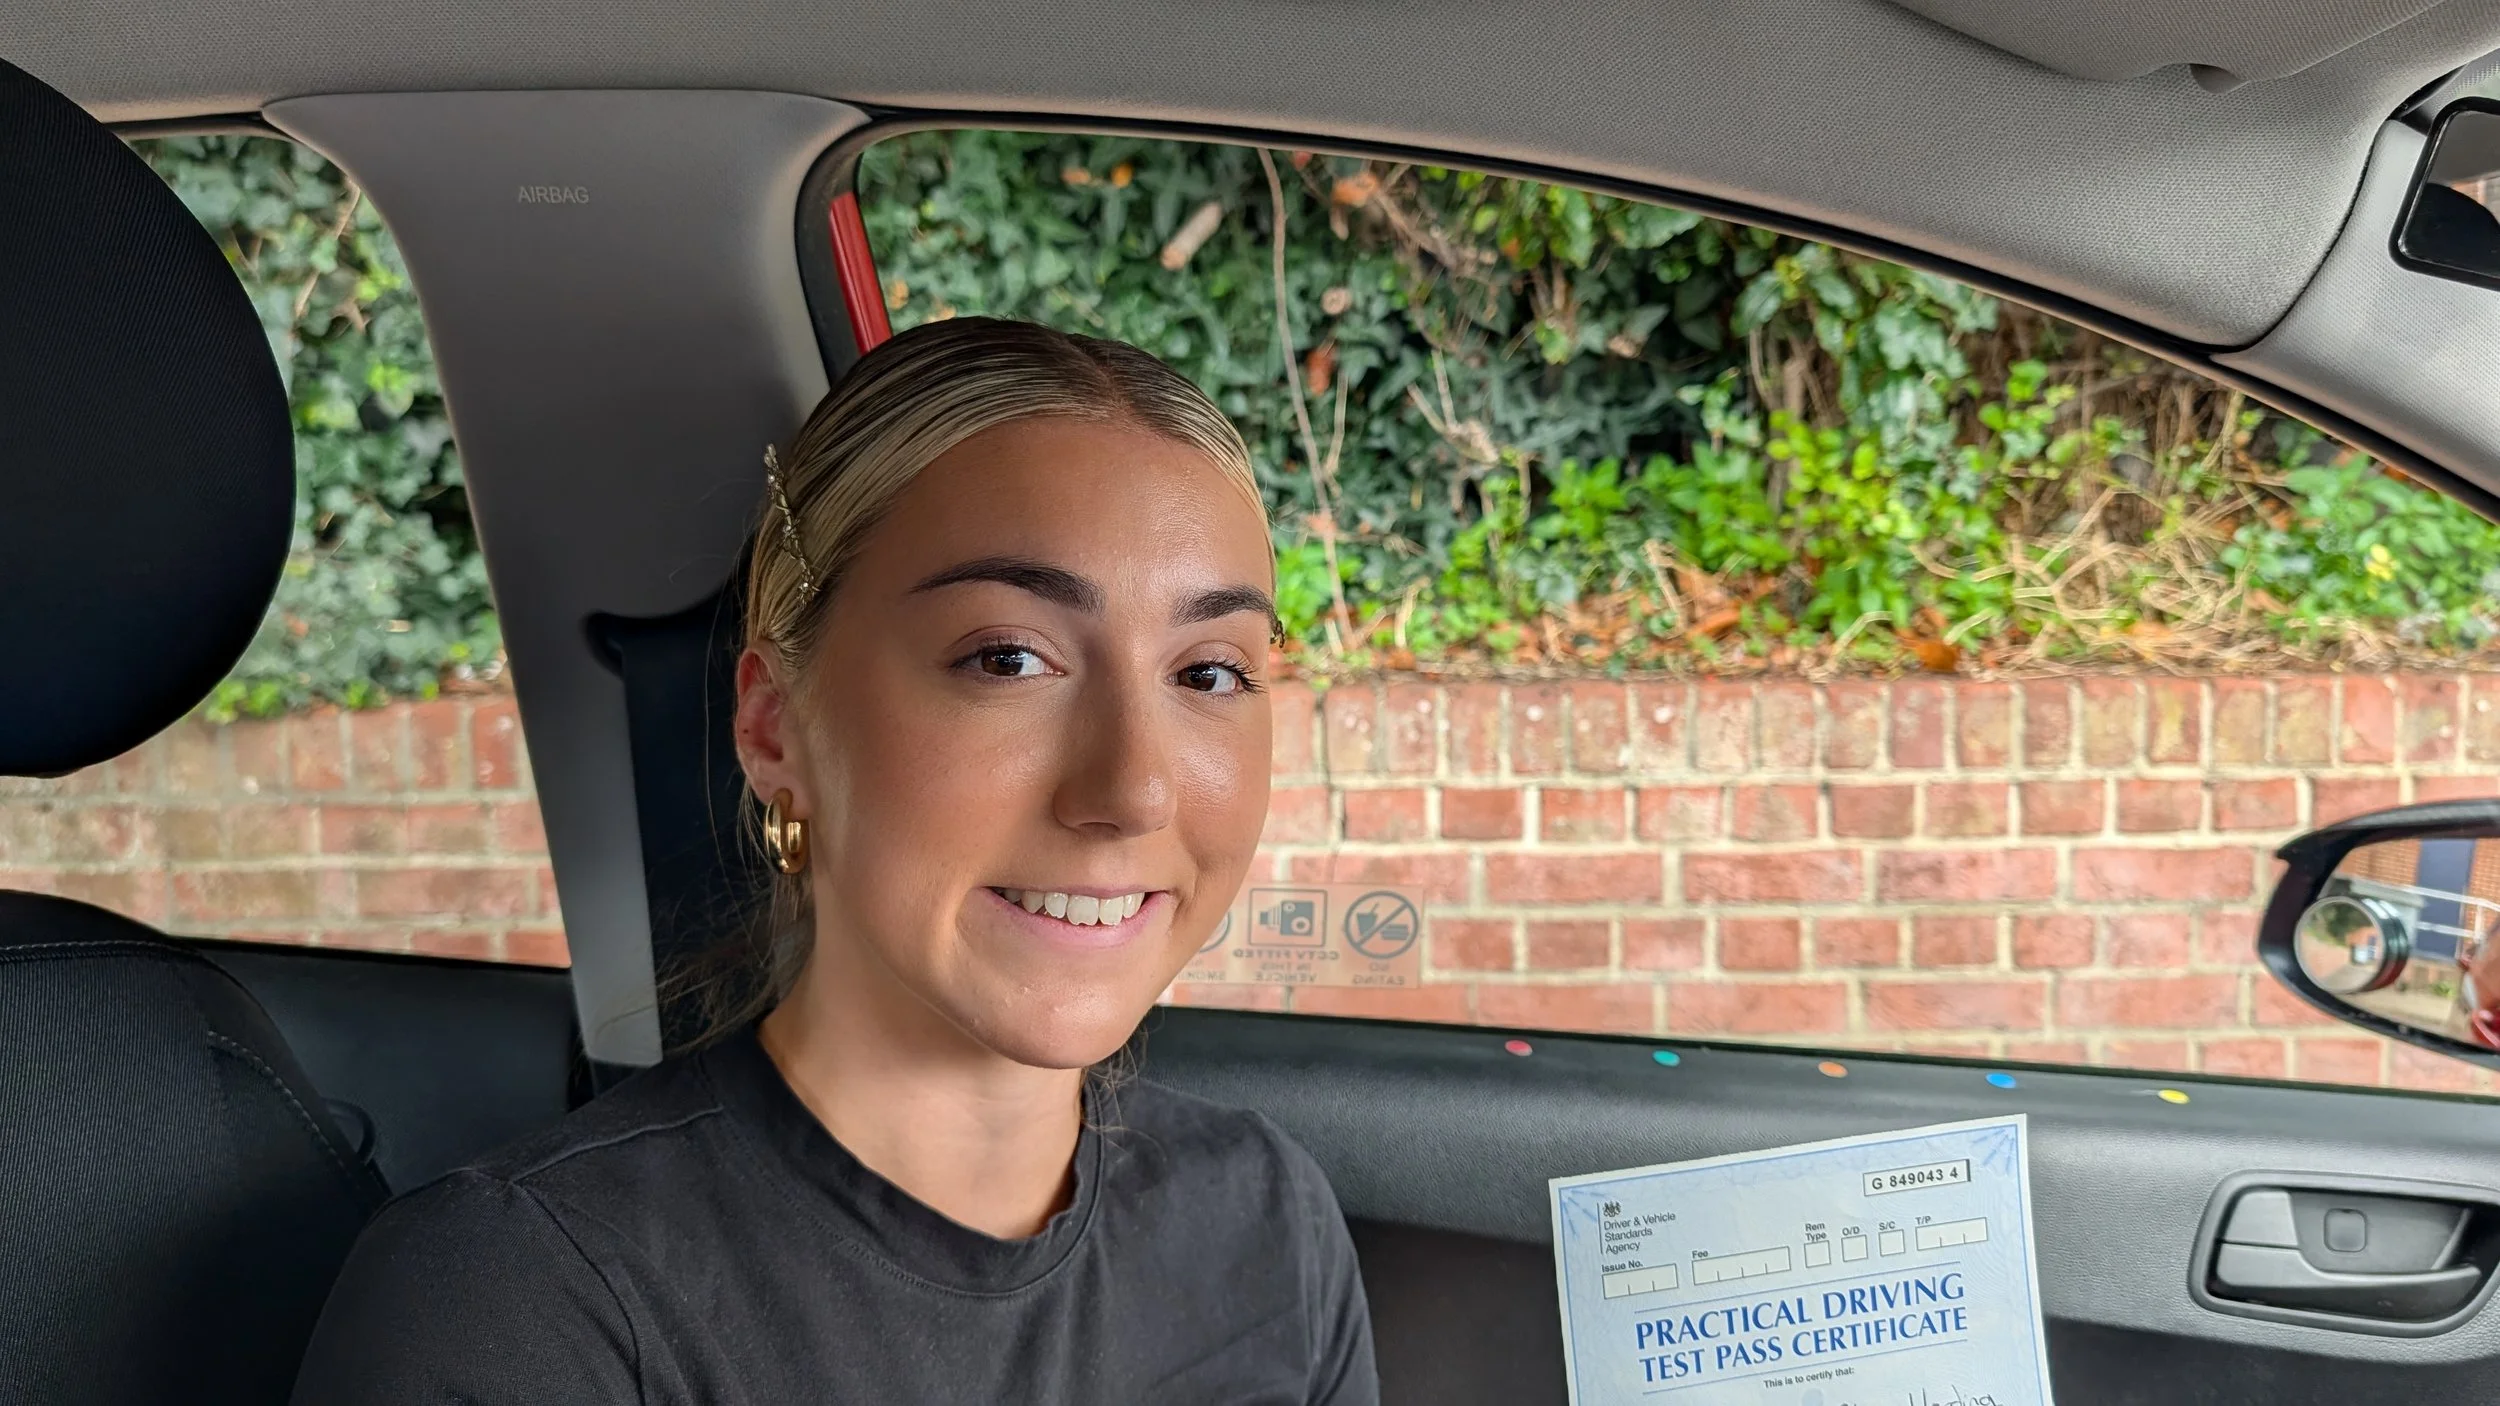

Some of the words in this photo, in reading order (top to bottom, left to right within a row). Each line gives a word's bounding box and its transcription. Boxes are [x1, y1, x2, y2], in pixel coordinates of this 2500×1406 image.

[518, 185, 590, 204] AIRBAG
[1871, 1177, 1883, 1190] G
[1889, 1168, 1944, 1188] 849043
[1949, 1166, 1958, 1179] 4
[1603, 1219, 1631, 1231] Driver
[1633, 1216, 1641, 1226] &
[1642, 1211, 1676, 1225] Vehicle
[1879, 1221, 1896, 1231] S/C
[1915, 1215, 1931, 1225] T/P
[1604, 1226, 1653, 1242] Standards
[1805, 1223, 1825, 1232] Rem
[1842, 1226, 1860, 1236] O/D
[1806, 1232, 1827, 1242] Type
[1605, 1241, 1641, 1255] Agency
[1691, 1249, 1709, 1259] Fee
[1601, 1262, 1626, 1273] Issue
[1628, 1259, 1644, 1269] No.
[1635, 1297, 1813, 1350] PRACTICAL
[1823, 1272, 1965, 1320] DRIVING
[1639, 1348, 1706, 1383] TEST
[1715, 1335, 1783, 1370] PASS
[1792, 1306, 1968, 1356] CERTIFICATE
[1763, 1378, 1783, 1389] This
[1784, 1376, 1793, 1386] is
[1794, 1374, 1804, 1384] to
[1806, 1370, 1833, 1383] certify
[1834, 1366, 1855, 1377] that:
